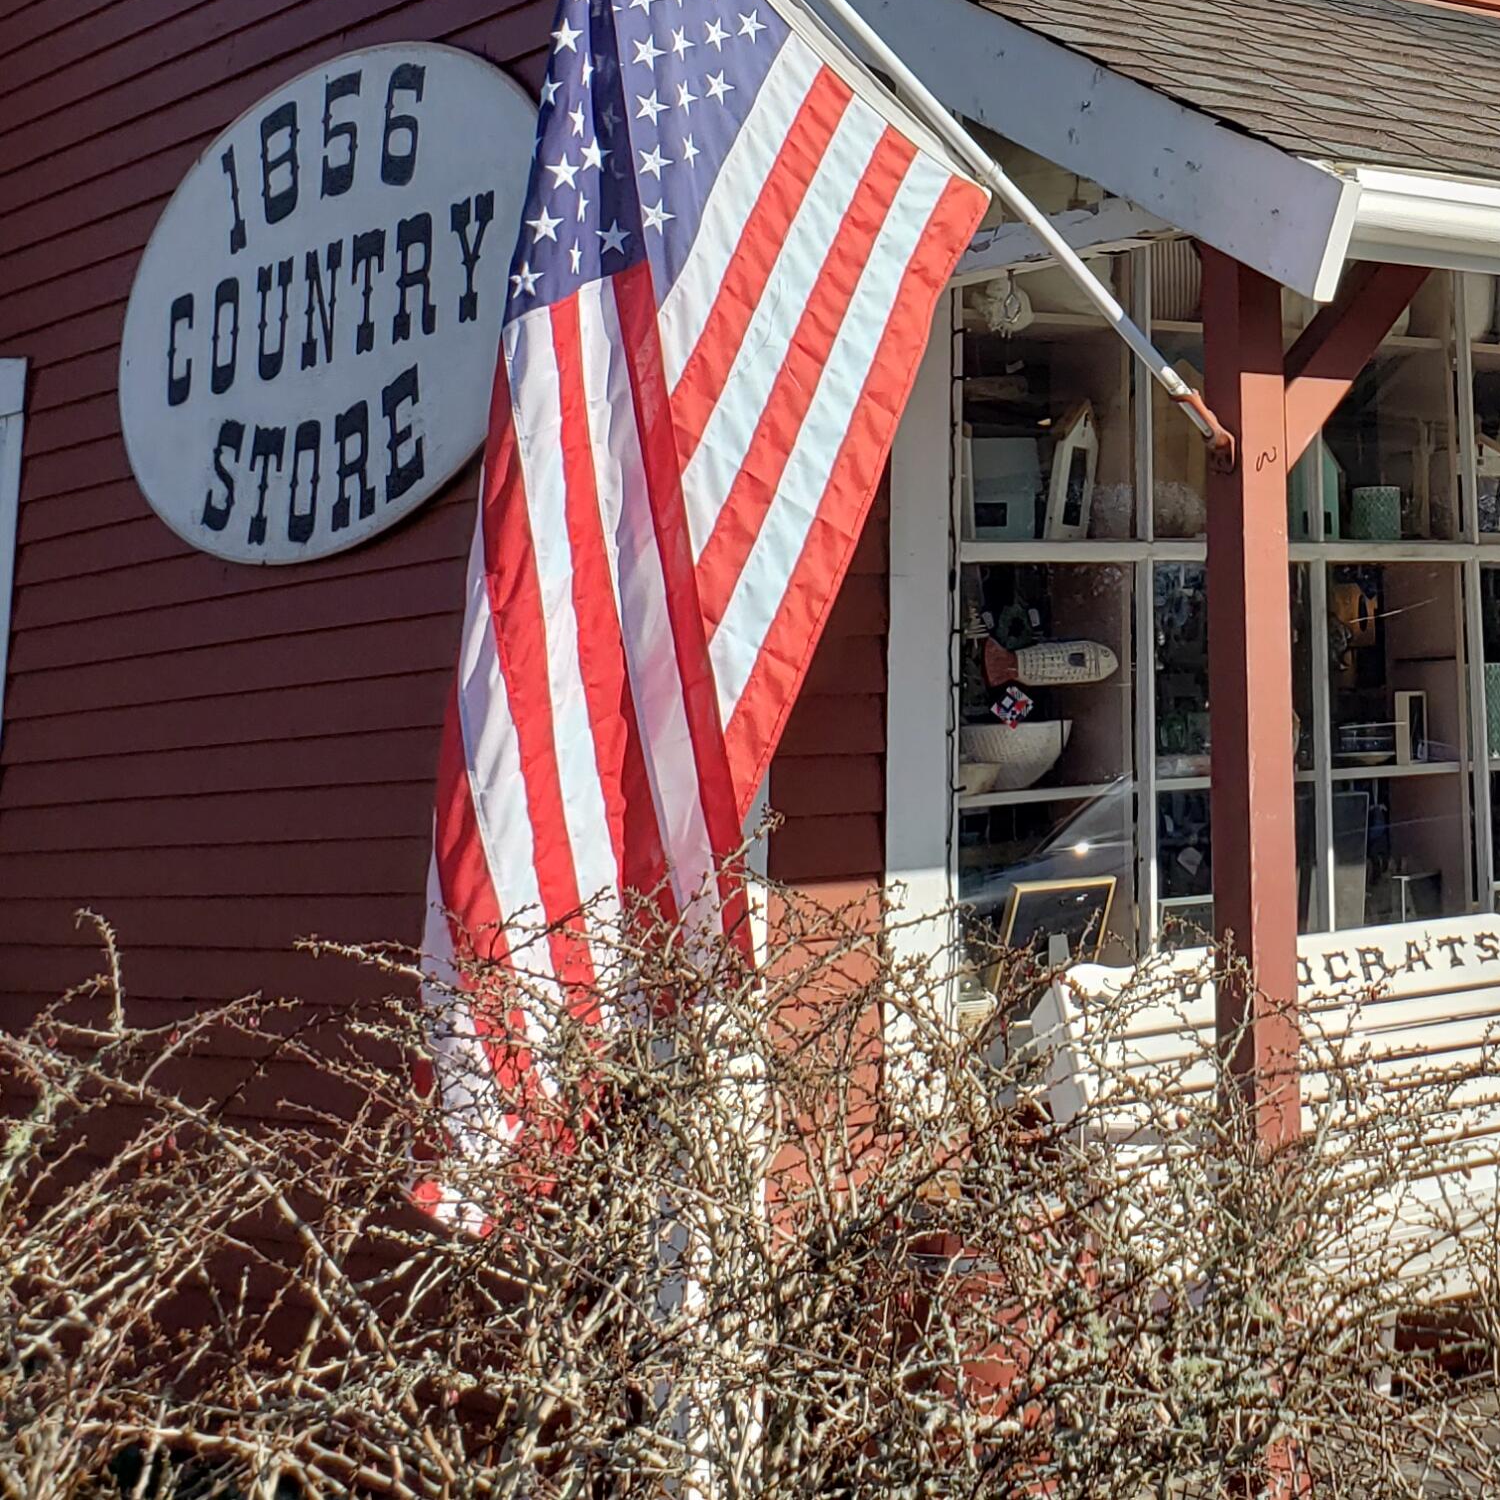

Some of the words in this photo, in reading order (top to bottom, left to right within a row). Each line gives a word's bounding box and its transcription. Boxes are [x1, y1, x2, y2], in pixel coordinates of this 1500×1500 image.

[220, 62, 427, 255] 1856
[167, 189, 495, 406] COUNTRY
[200, 363, 426, 546] STORE
